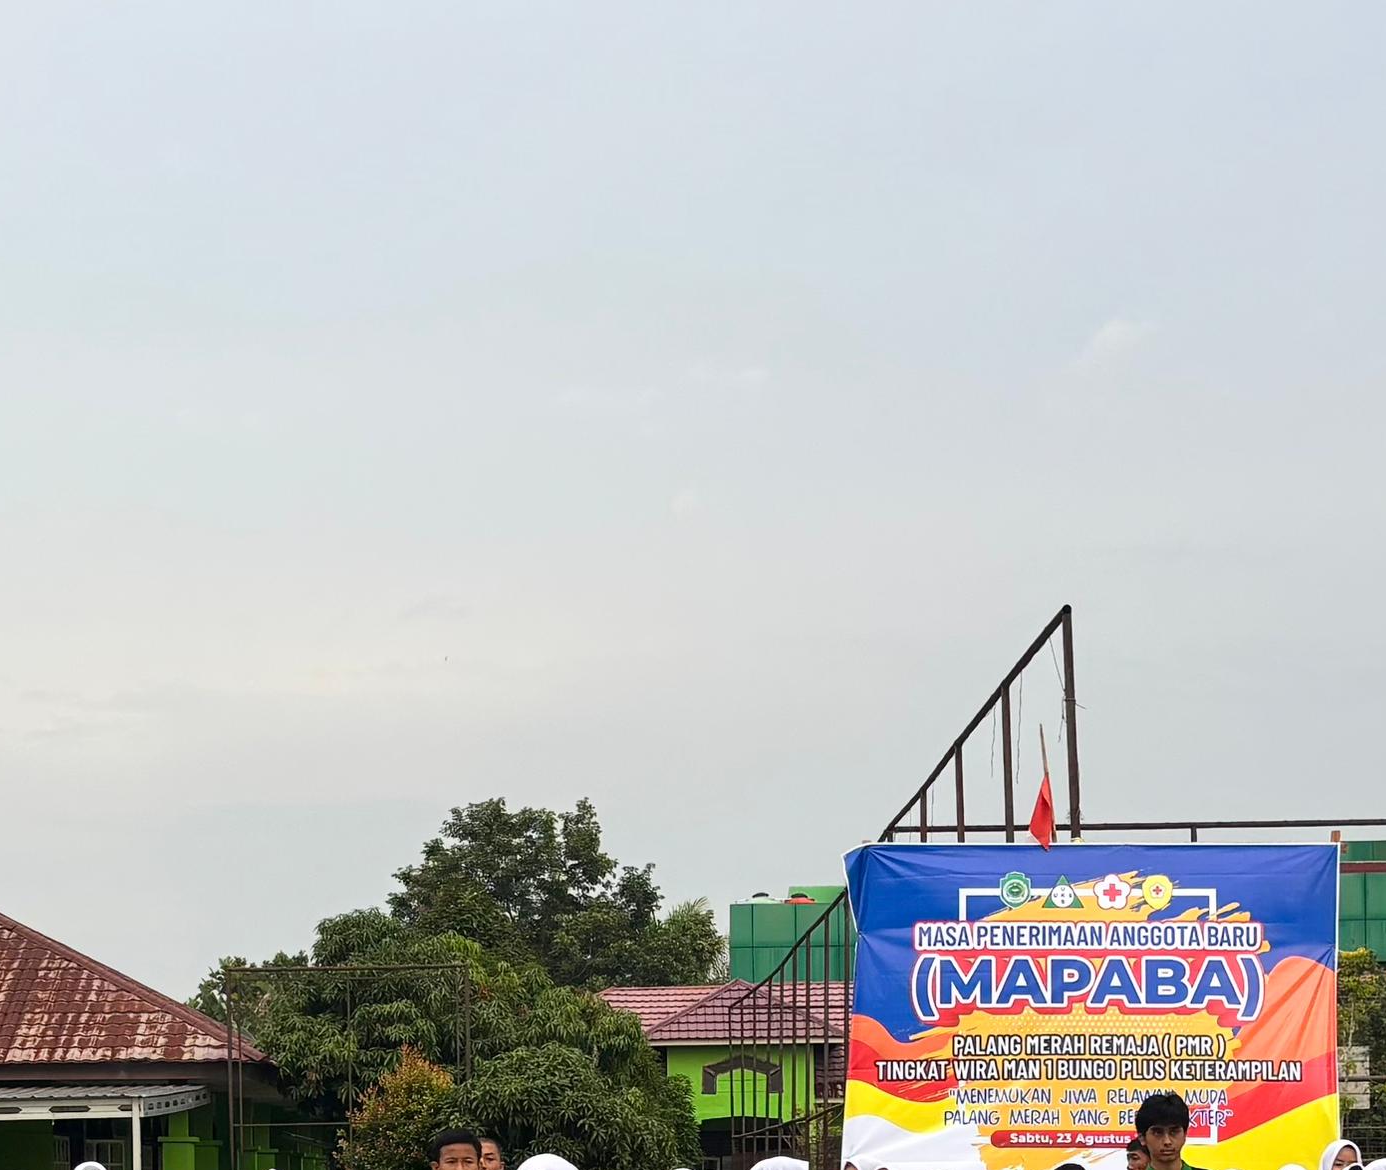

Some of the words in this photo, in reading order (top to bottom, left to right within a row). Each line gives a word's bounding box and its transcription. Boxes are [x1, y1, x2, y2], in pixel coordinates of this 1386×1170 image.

[918, 925, 971, 947] MASA
[976, 925, 1103, 947] PENERIMAAN
[1111, 924, 1200, 947] ANGGOTA
[1207, 924, 1259, 947] BARU
[914, 955, 1263, 1020] (MAPABA)
[953, 1034, 1022, 1057] PALANG
[1026, 1034, 1086, 1057] MERAH
[1088, 1034, 1160, 1057] REMAJA
[875, 1060, 949, 1082] TINGKAT
[952, 1060, 1000, 1082] WIRA
[1002, 1060, 1040, 1081] MAN
[1044, 1060, 1054, 1081] 1
[1056, 1060, 1116, 1081] BUNGO
[1121, 1060, 1167, 1081] PLUS
[1168, 1060, 1303, 1082] KETERAMPILAN
[1060, 1088, 1097, 1105] JIWA
[1184, 1088, 1228, 1105] MUDA
[944, 1109, 1001, 1126] PALANG
[1009, 1109, 1060, 1126] MERAH
[1070, 1109, 1110, 1126] YANG
[1009, 1132, 1053, 1145] Sabtu,
[1056, 1133, 1072, 1143] 23
[1075, 1132, 1132, 1145] Agustus
